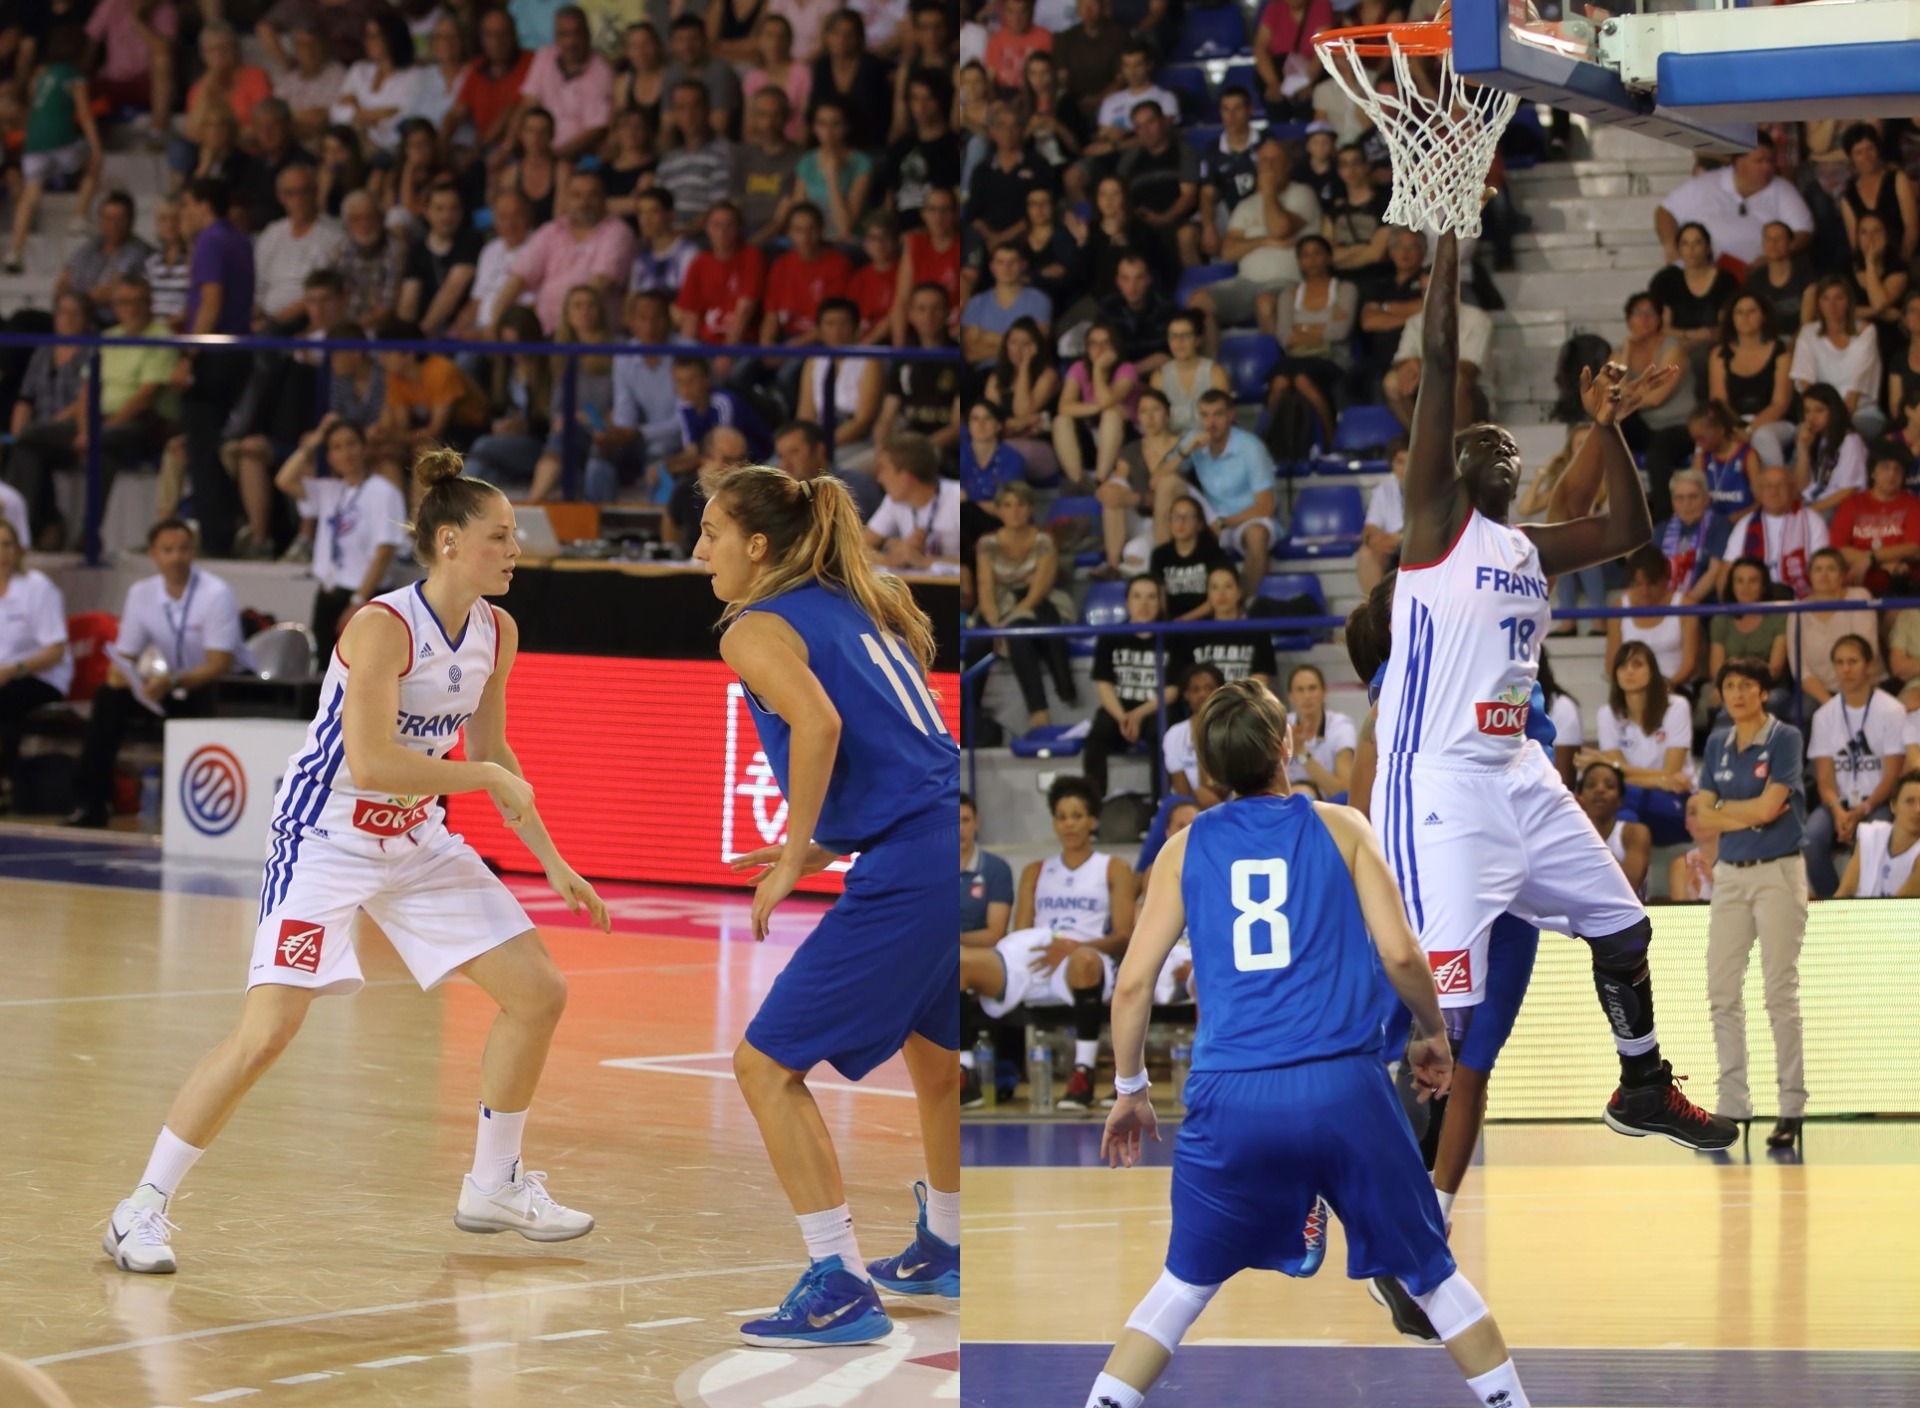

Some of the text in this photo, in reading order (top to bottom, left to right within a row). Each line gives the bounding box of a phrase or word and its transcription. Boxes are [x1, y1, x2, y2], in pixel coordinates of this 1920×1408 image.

[1499, 616, 1536, 663] 18
[859, 630, 948, 736] 11
[1037, 896, 1098, 912] FRANCE
[1230, 858, 1291, 972] 8
